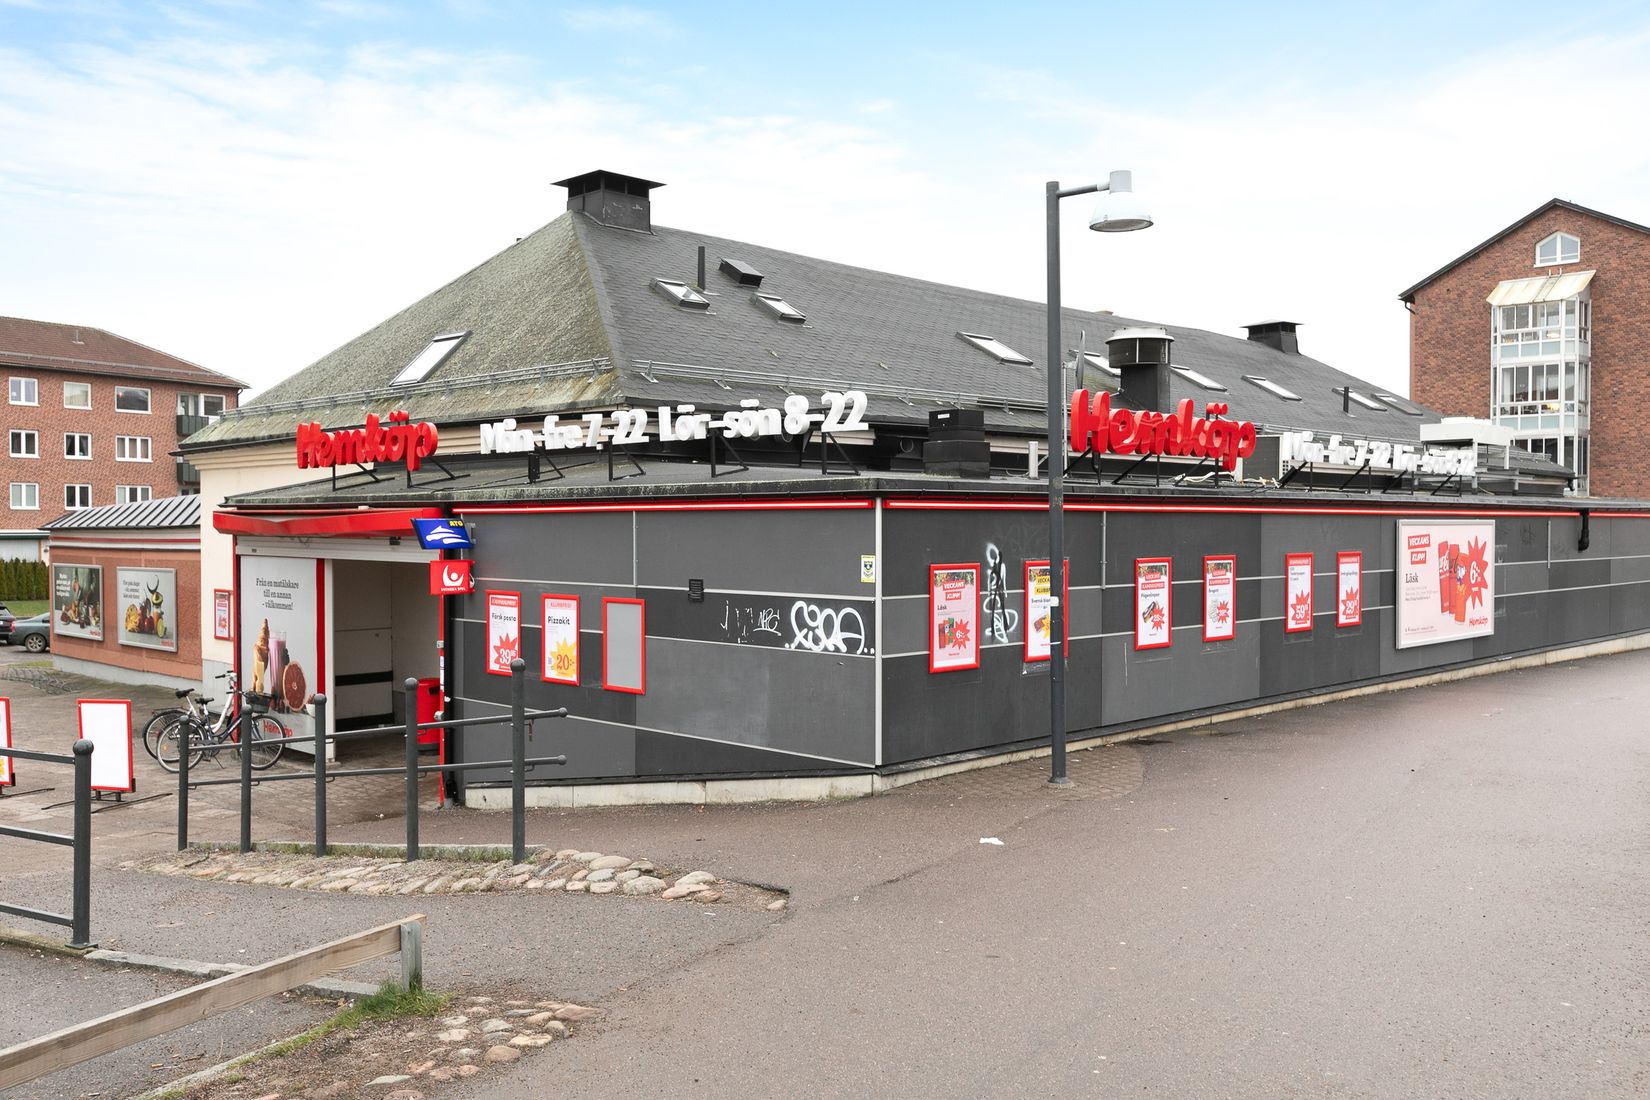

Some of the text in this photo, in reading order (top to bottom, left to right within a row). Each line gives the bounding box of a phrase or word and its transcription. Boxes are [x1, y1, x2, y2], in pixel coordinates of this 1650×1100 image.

[784, 391, 868, 434] 8-22
[296, 410, 439, 472] Hemköp
[1070, 388, 1257, 472] Hemköp
[256, 577, 267, 587] Från
[1405, 572, 1419, 583] Läsk
[547, 615, 571, 625] Pizzakit
